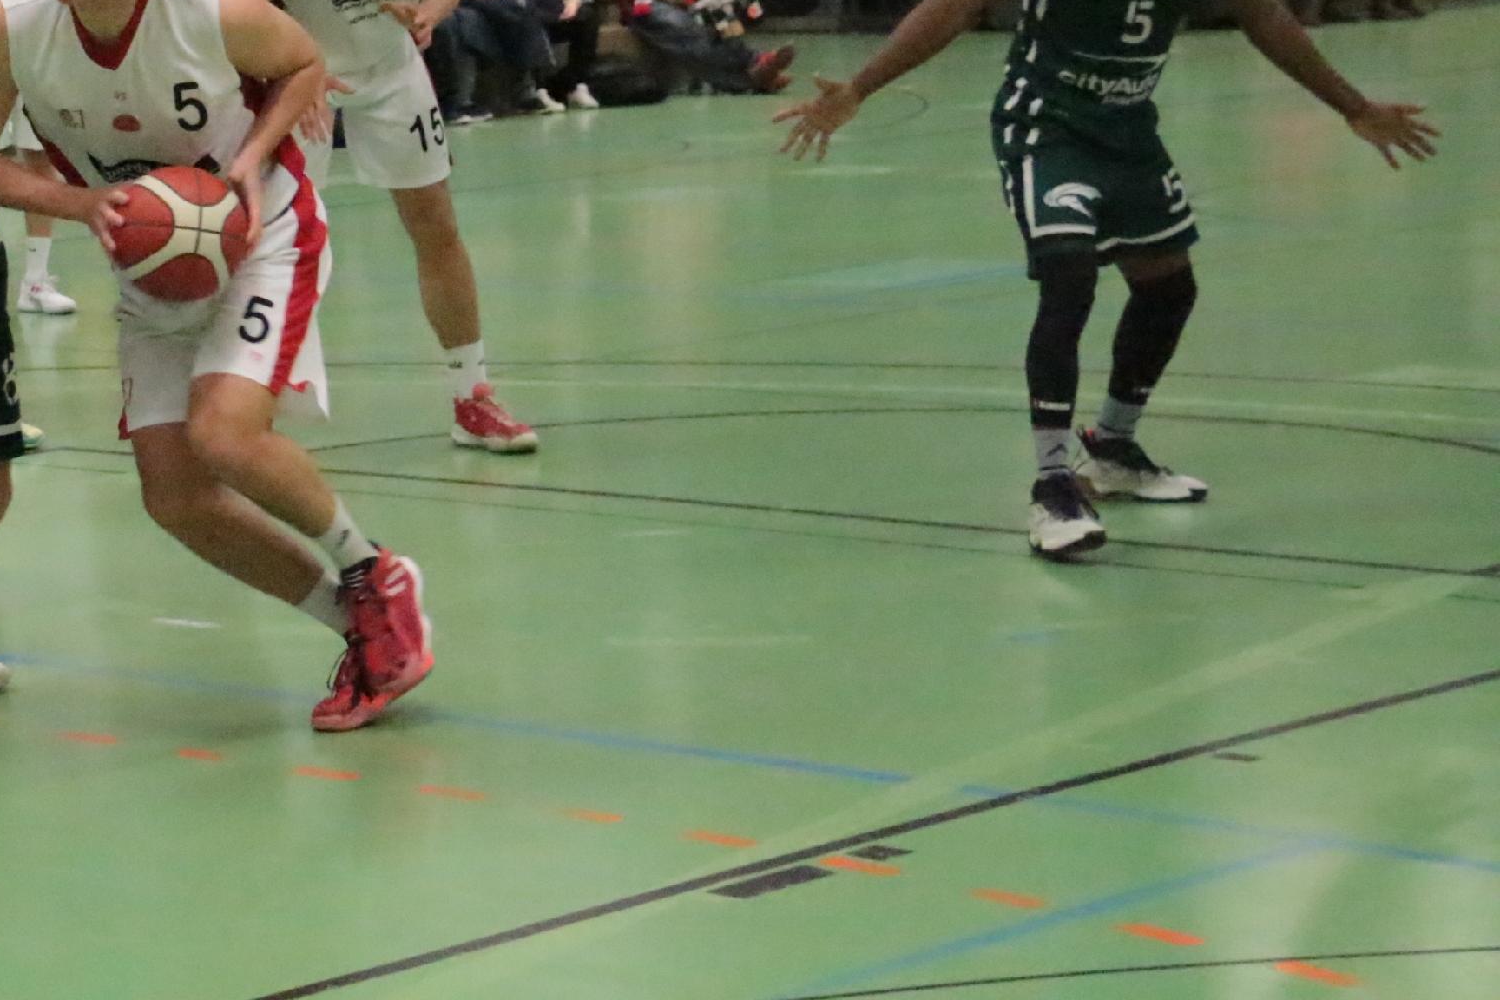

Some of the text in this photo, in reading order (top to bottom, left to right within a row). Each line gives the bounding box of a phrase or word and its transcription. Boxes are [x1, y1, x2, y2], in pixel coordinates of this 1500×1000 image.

[1120, 0, 1155, 44] 5
[173, 81, 208, 132] 5
[409, 106, 445, 152] 15
[239, 295, 274, 343] 5
